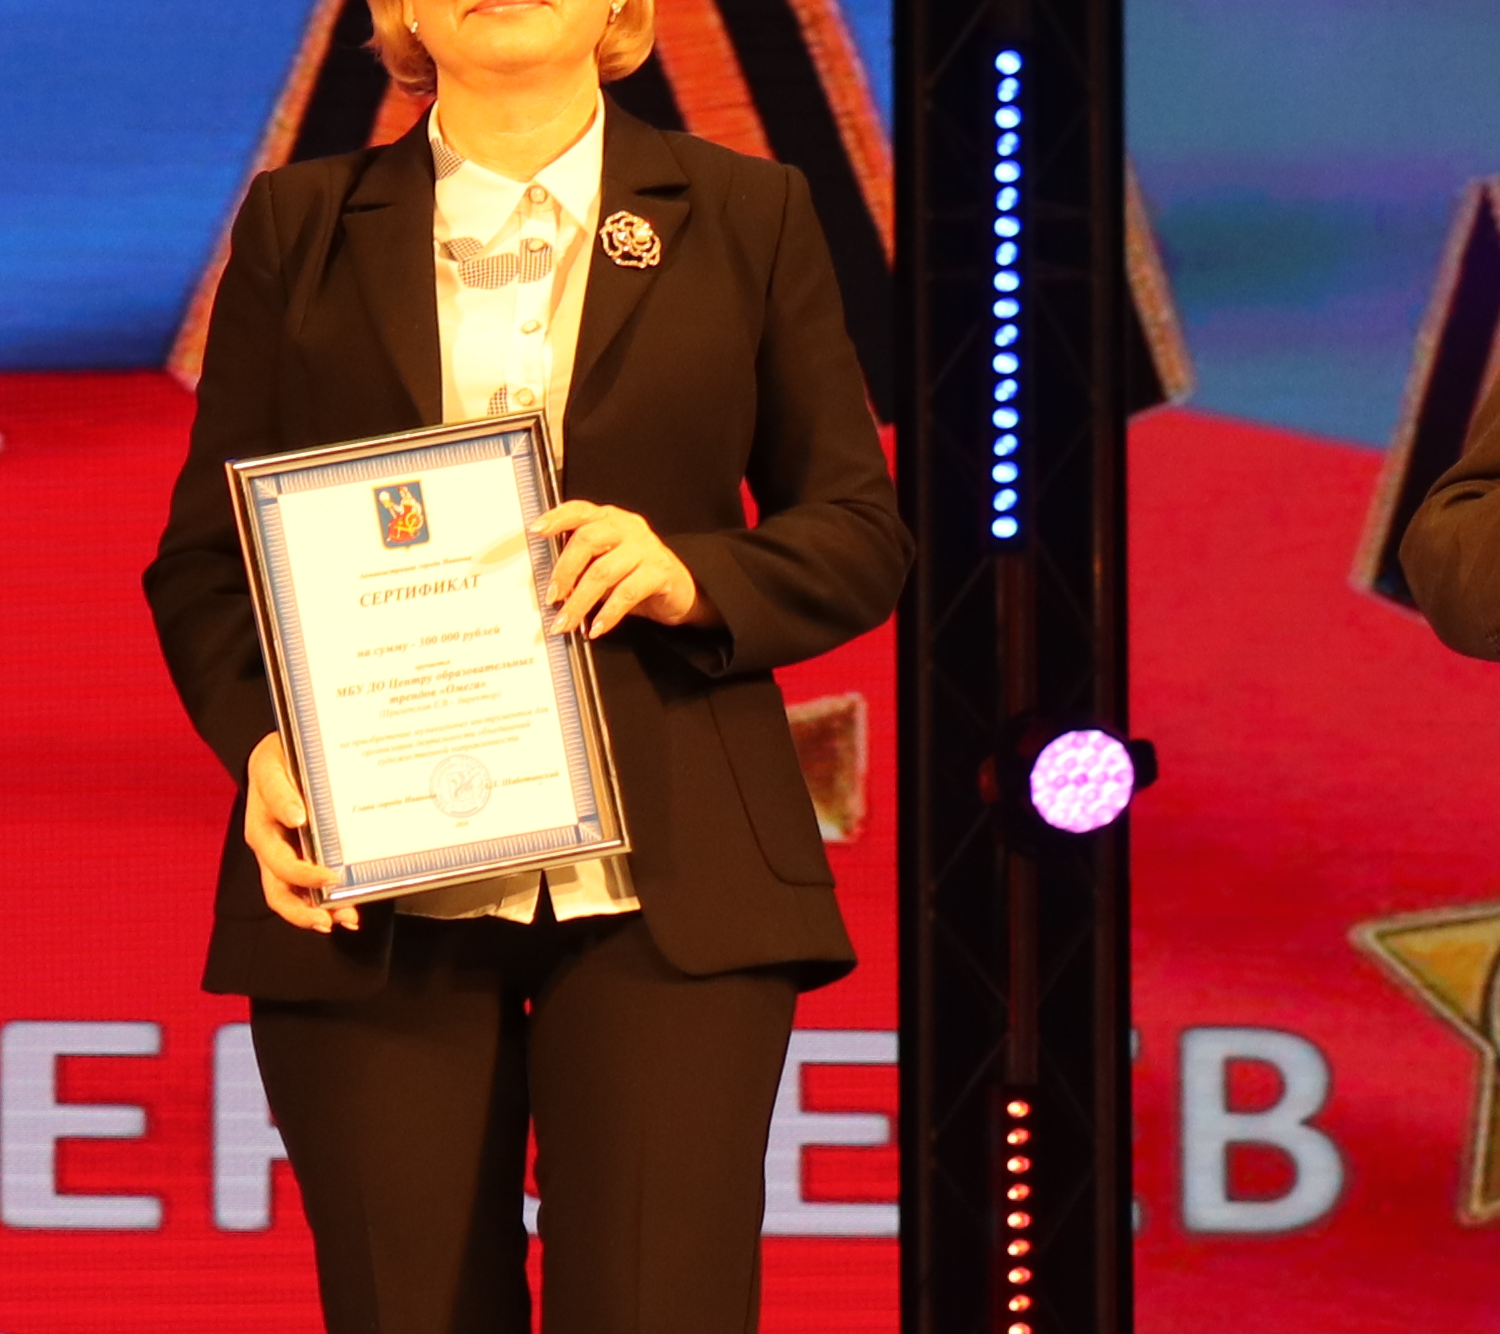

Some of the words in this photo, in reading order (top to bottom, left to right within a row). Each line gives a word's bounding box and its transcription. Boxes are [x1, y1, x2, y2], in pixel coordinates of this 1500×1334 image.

[358, 573, 481, 606] СЕРТИФИКАТ
[372, 643, 408, 654] сумму
[462, 626, 501, 640] рублей
[336, 685, 363, 696] МБУ
[388, 675, 432, 688] Центру
